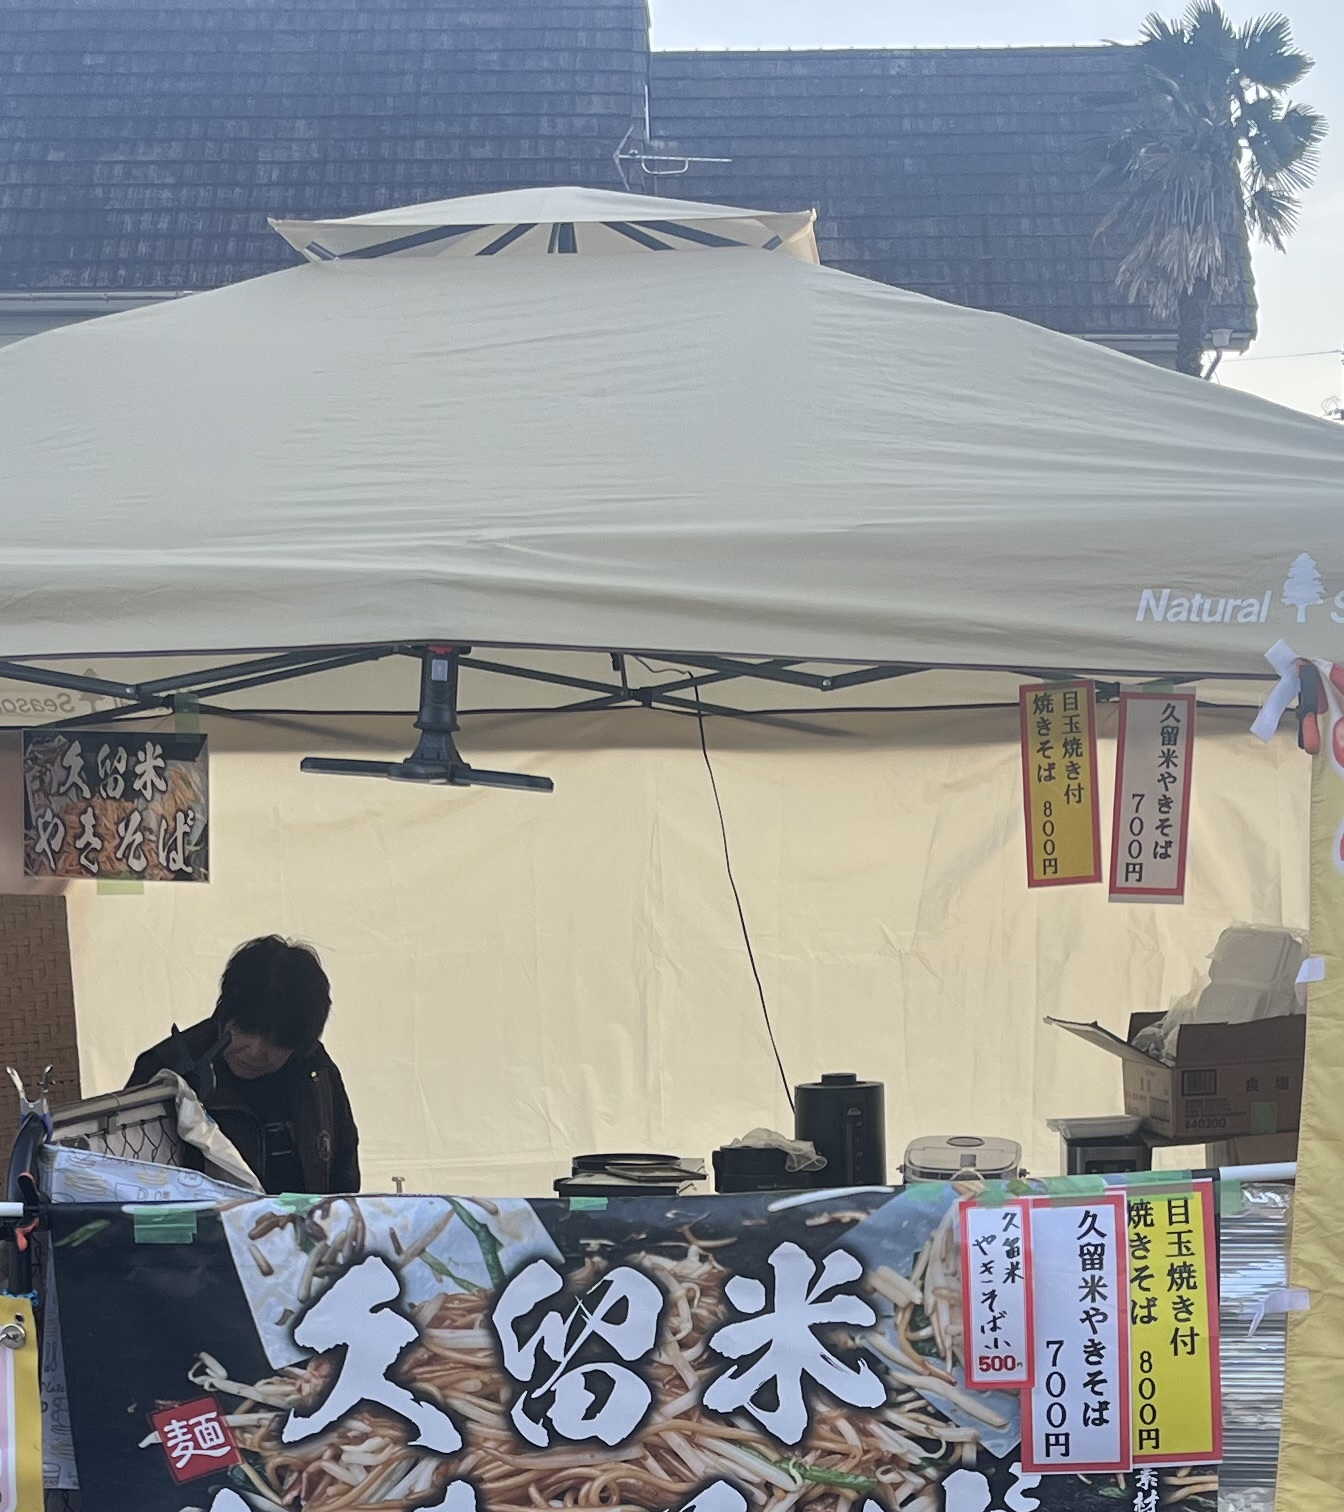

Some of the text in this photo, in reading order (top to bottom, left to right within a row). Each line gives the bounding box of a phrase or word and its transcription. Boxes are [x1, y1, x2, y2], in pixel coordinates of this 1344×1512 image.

[1135, 588, 1272, 624] Natural
[60, 740, 168, 802] 久留米
[1032, 693, 1058, 875] 焼きそば 800円
[1061, 690, 1085, 805] 目玉焼き付
[1153, 703, 1182, 860] 久留米やきそば
[34, 806, 197, 873] やきそば
[1124, 793, 1146, 883] 700円
[1002, 1212, 1025, 1284] 久留米
[1165, 1197, 1200, 1356] 目玉焼き付
[282, 1241, 888, 1454] 久留米
[1077, 1210, 1111, 1427] 久留米やきそば
[1127, 1199, 1160, 1450] 焼きそば 800円
[1044, 1340, 1071, 1458] 700円
